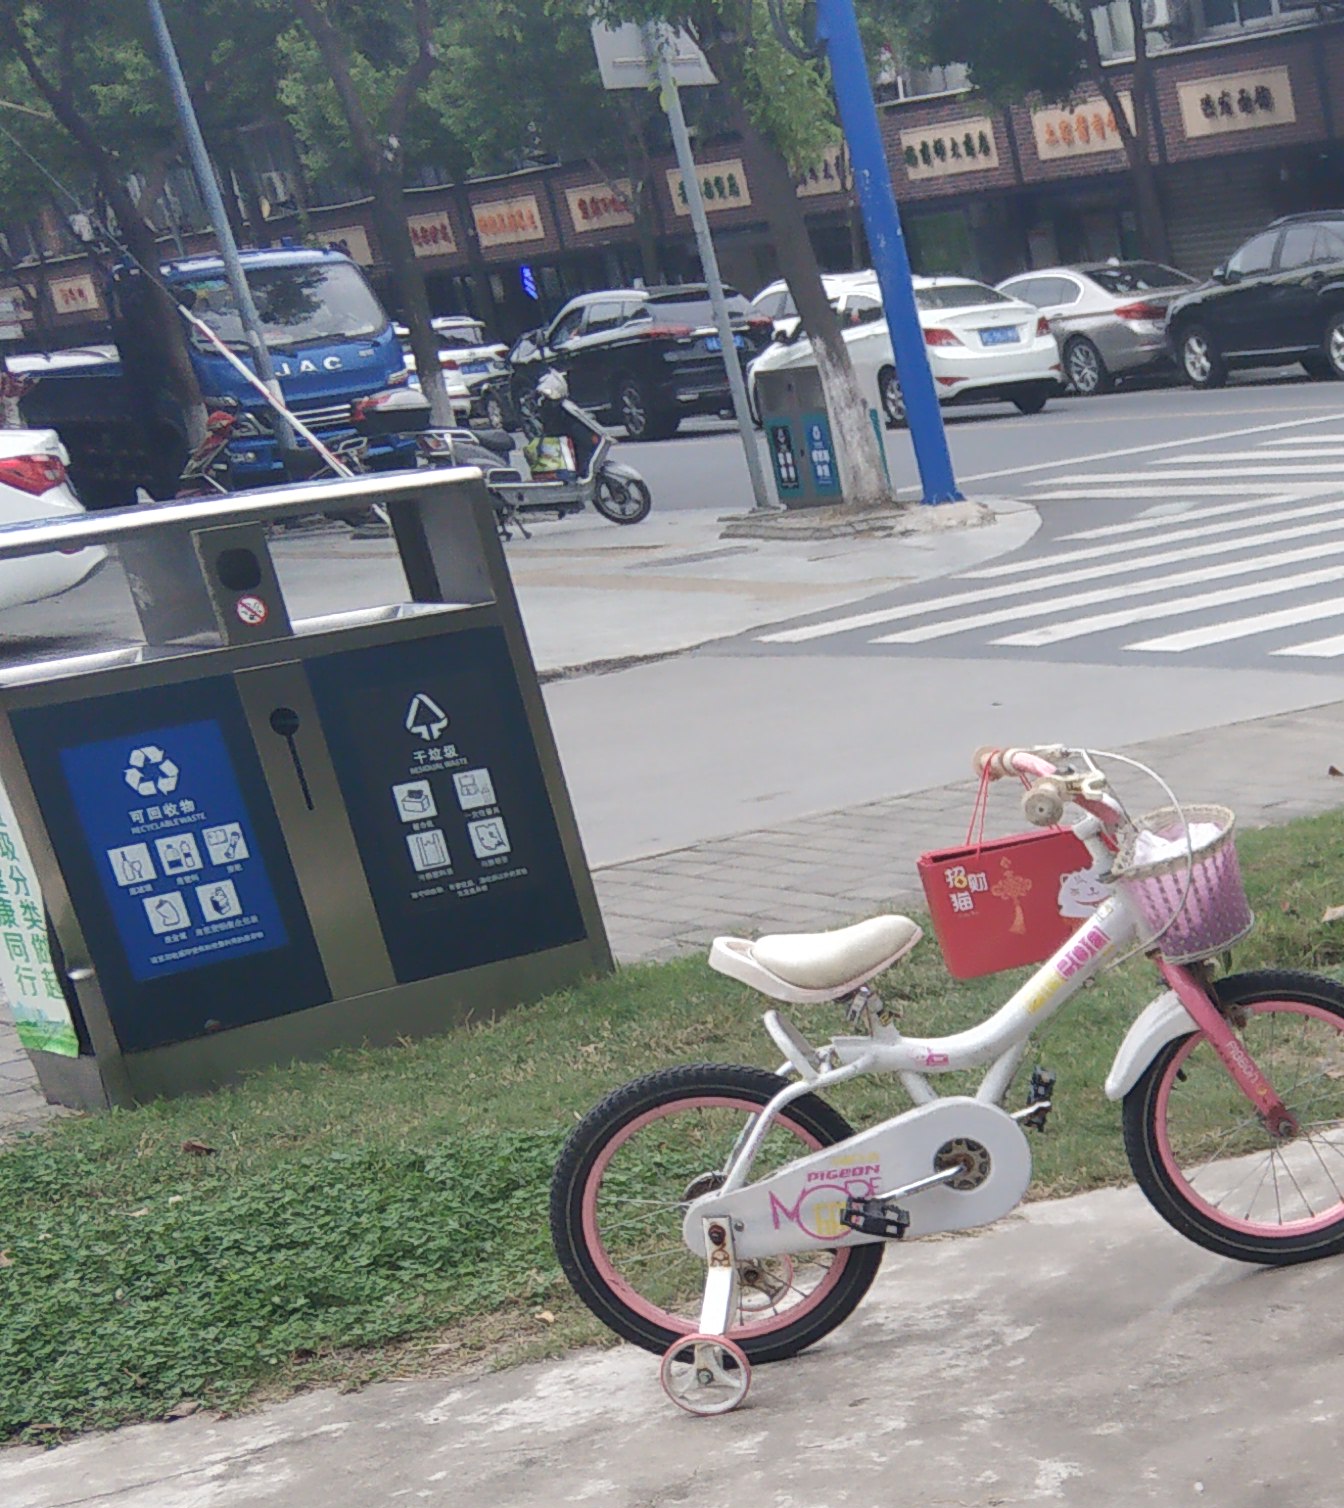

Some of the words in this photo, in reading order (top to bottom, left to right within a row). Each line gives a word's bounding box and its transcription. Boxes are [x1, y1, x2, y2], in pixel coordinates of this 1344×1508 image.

[274, 355, 343, 377] JAC
[413, 745, 459, 764] 干垃圾
[444, 757, 468, 769] WASTE
[128, 799, 196, 824] 可回收物
[944, 865, 989, 913] 招财猫
